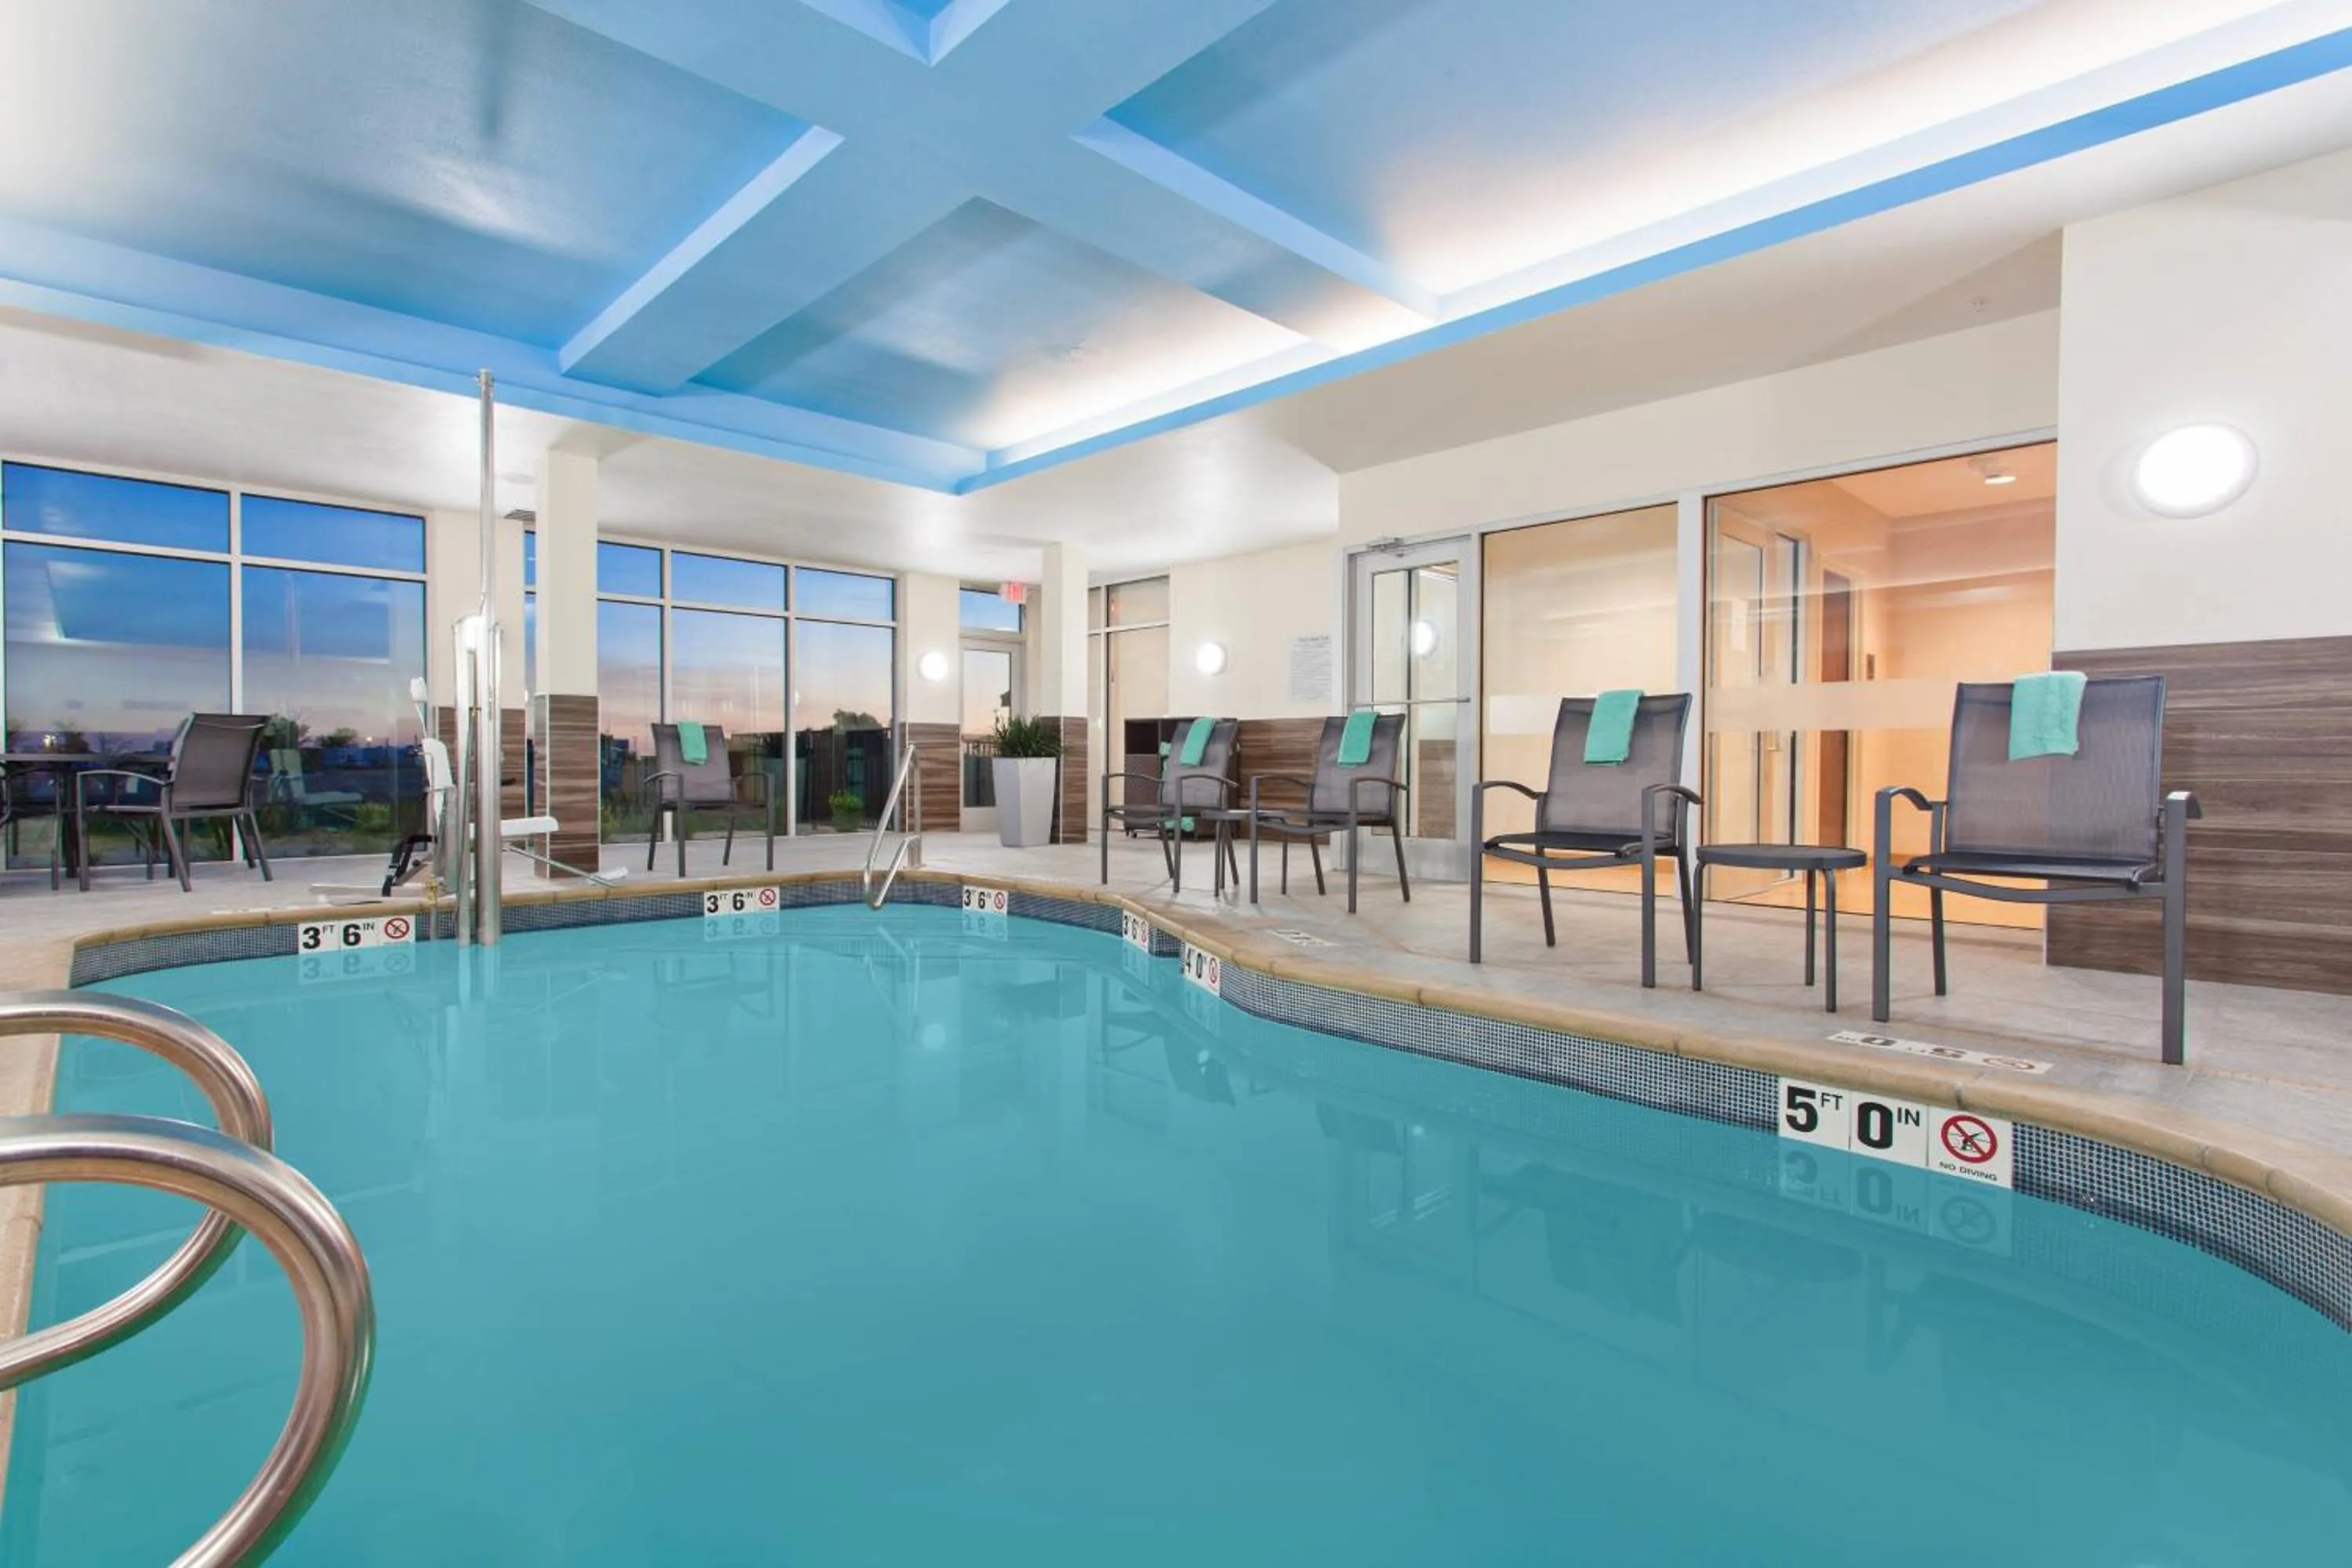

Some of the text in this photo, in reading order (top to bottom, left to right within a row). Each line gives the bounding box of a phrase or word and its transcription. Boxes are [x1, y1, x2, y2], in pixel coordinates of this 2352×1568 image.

[706, 895, 719, 913] 3
[732, 893, 745, 911] 6
[964, 889, 971, 906] 3
[978, 891, 985, 909] 6
[303, 926, 321, 949] 3
[322, 924, 336, 934] FT
[343, 924, 361, 946] 6
[1131, 918, 1137, 940] 6
[1186, 949, 1203, 978] 4 0
[1785, 1085, 1920, 1150] 5 FT 0 IN
[1939, 1161, 1998, 1181] NO DIVING
